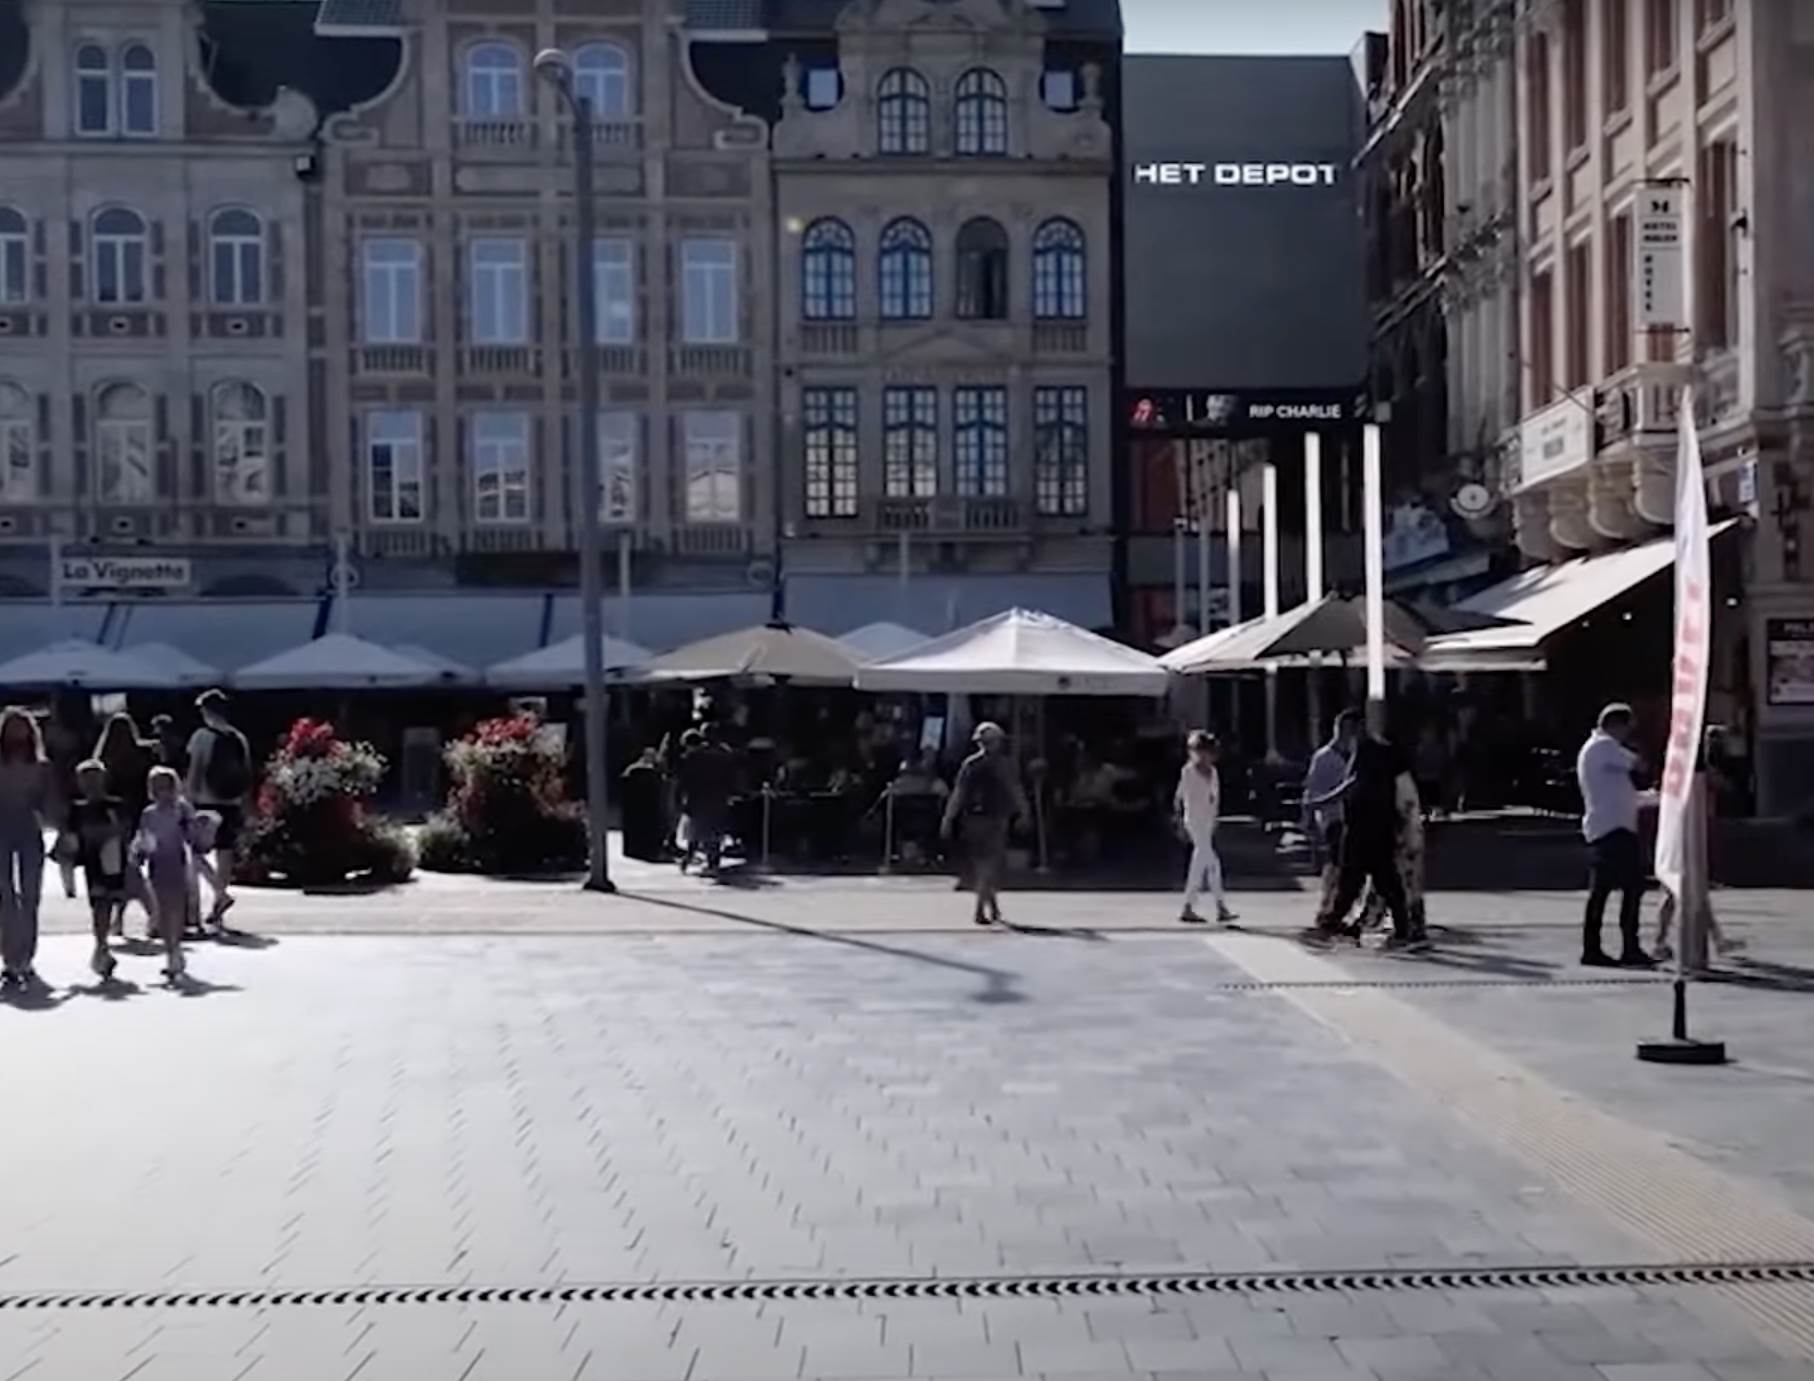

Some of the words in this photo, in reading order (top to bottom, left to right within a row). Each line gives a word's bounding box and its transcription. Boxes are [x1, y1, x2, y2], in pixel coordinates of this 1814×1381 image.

[1134, 163, 1205, 184] HET
[1214, 163, 1337, 185] DEPOT
[1249, 404, 1275, 419] RIP
[1276, 404, 1342, 419] CHARLIE
[63, 562, 89, 579] La
[94, 560, 184, 584] Vignette
